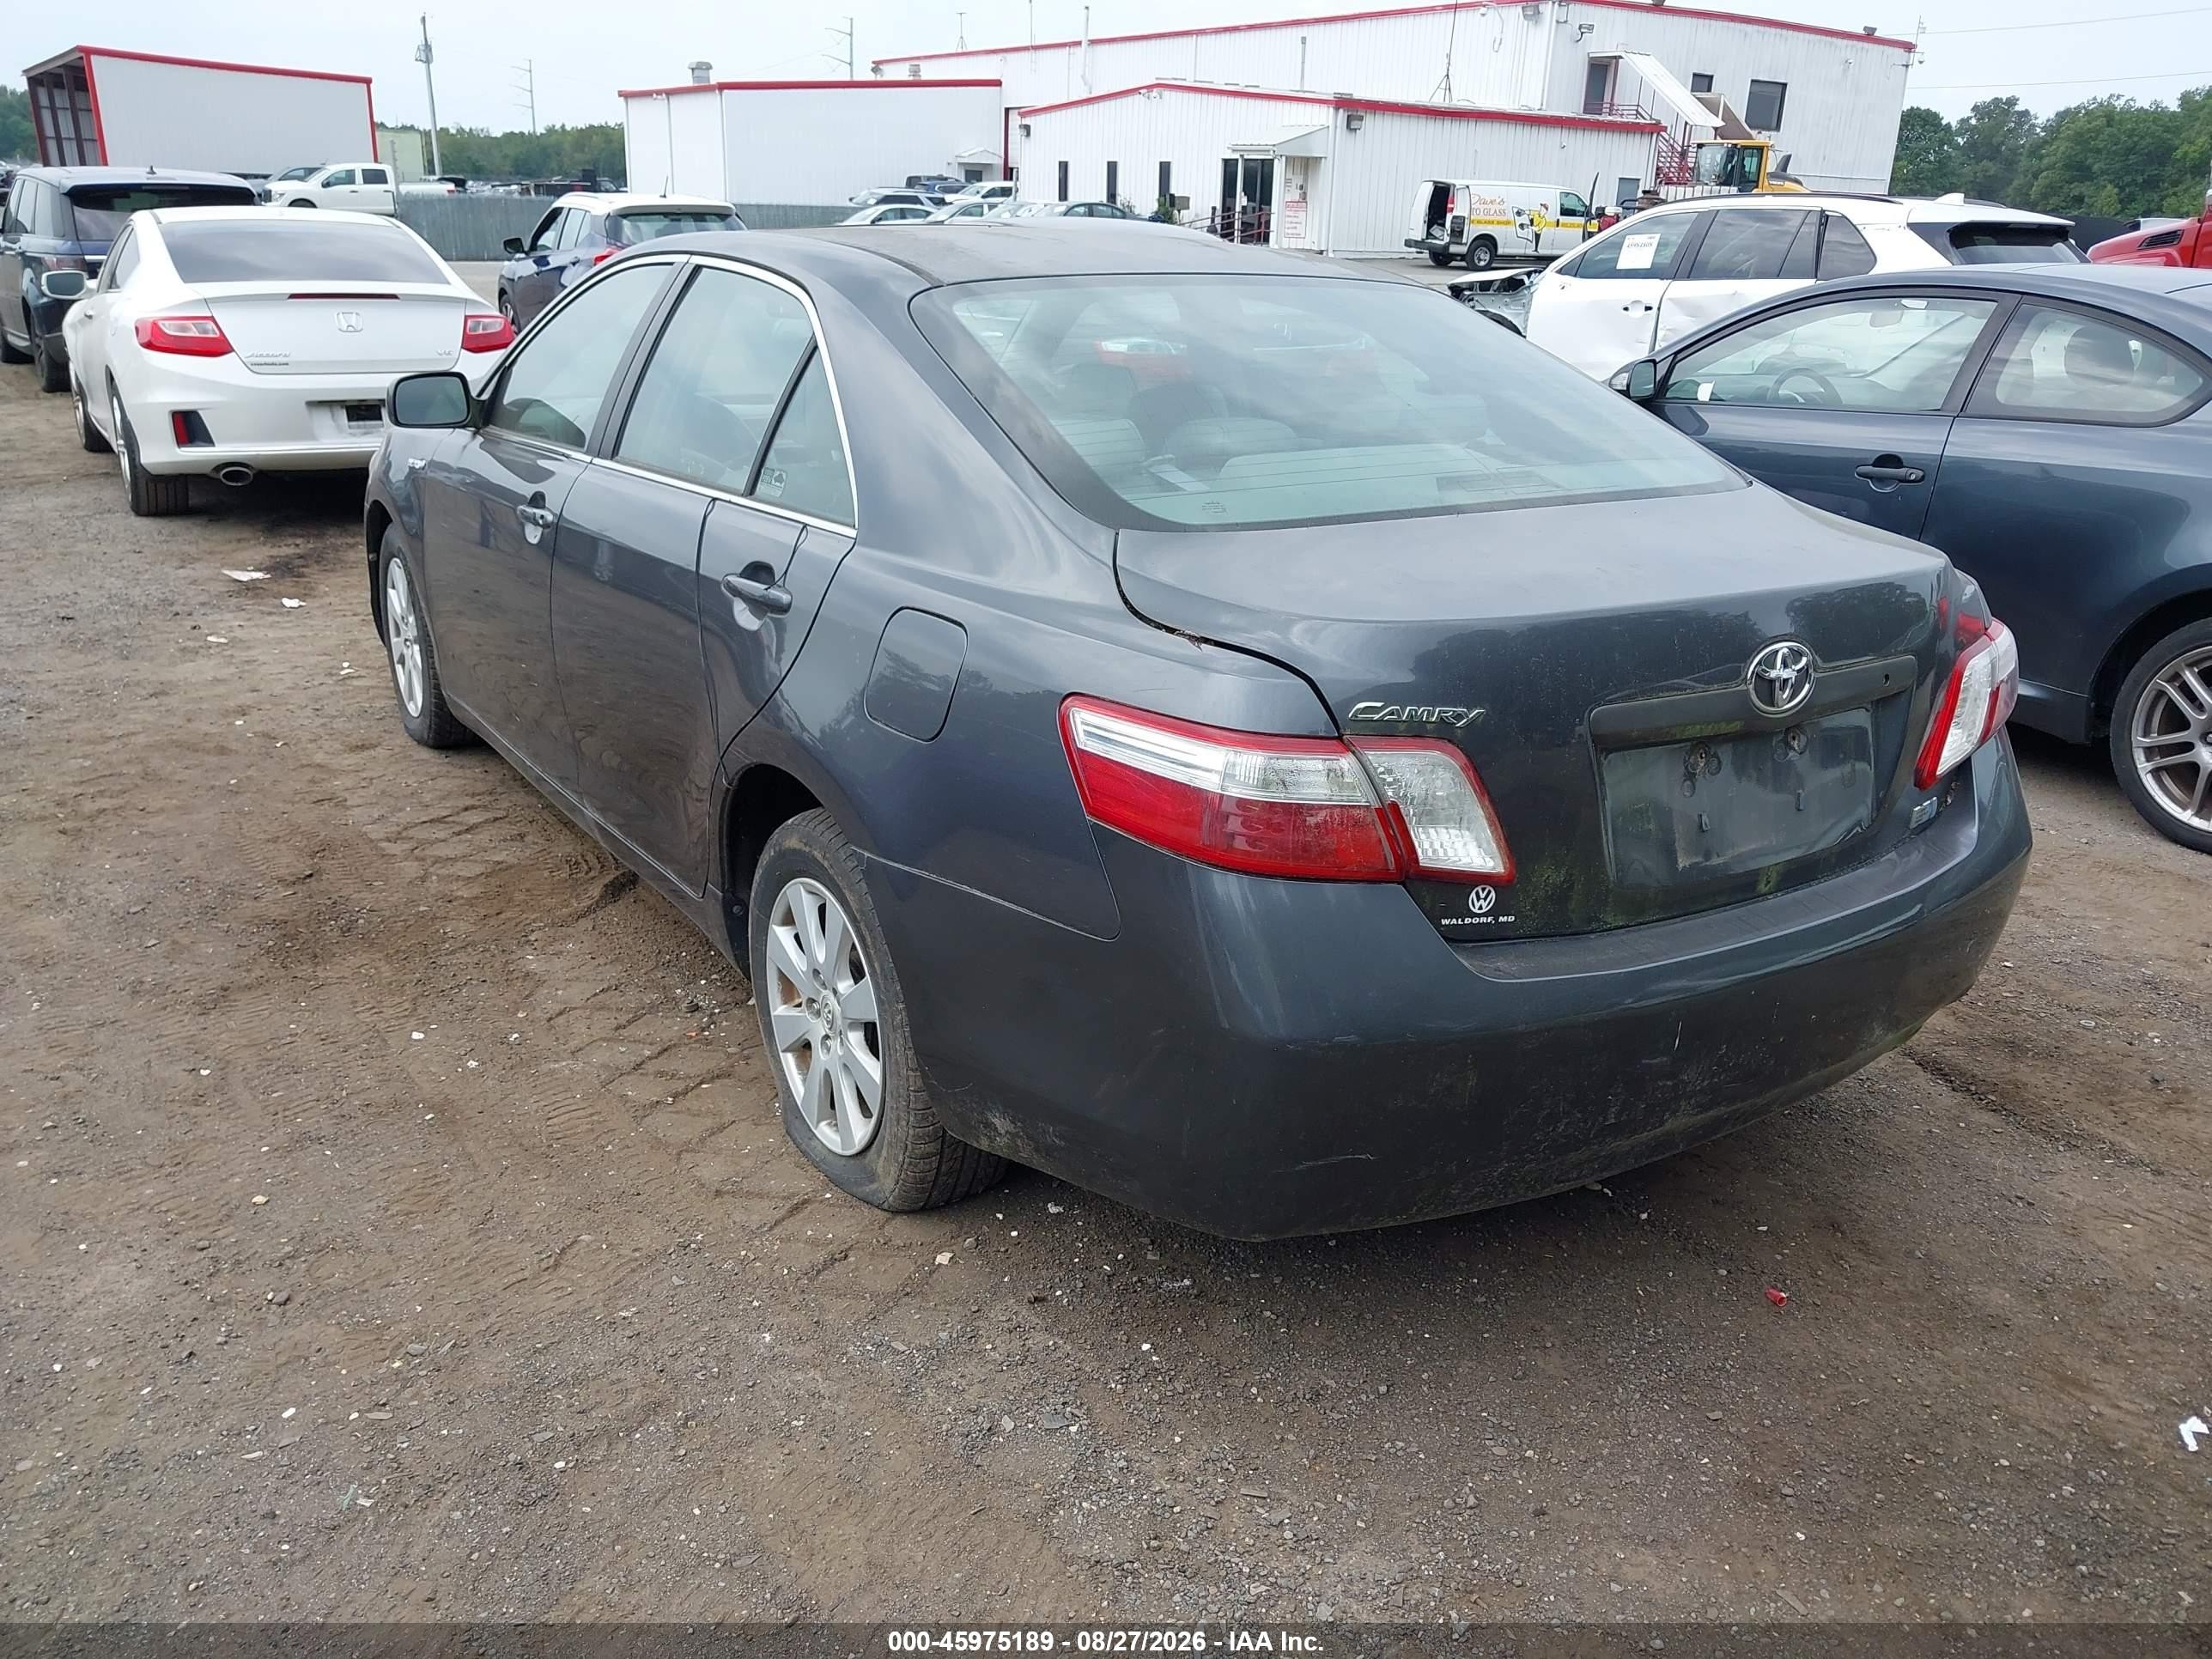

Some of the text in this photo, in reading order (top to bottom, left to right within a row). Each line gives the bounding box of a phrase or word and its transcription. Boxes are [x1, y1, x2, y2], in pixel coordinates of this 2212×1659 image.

[1483, 208, 1506, 216] GLASS
[1348, 701, 1486, 728] CAMRY
[1441, 916, 1495, 925] WALDORF,
